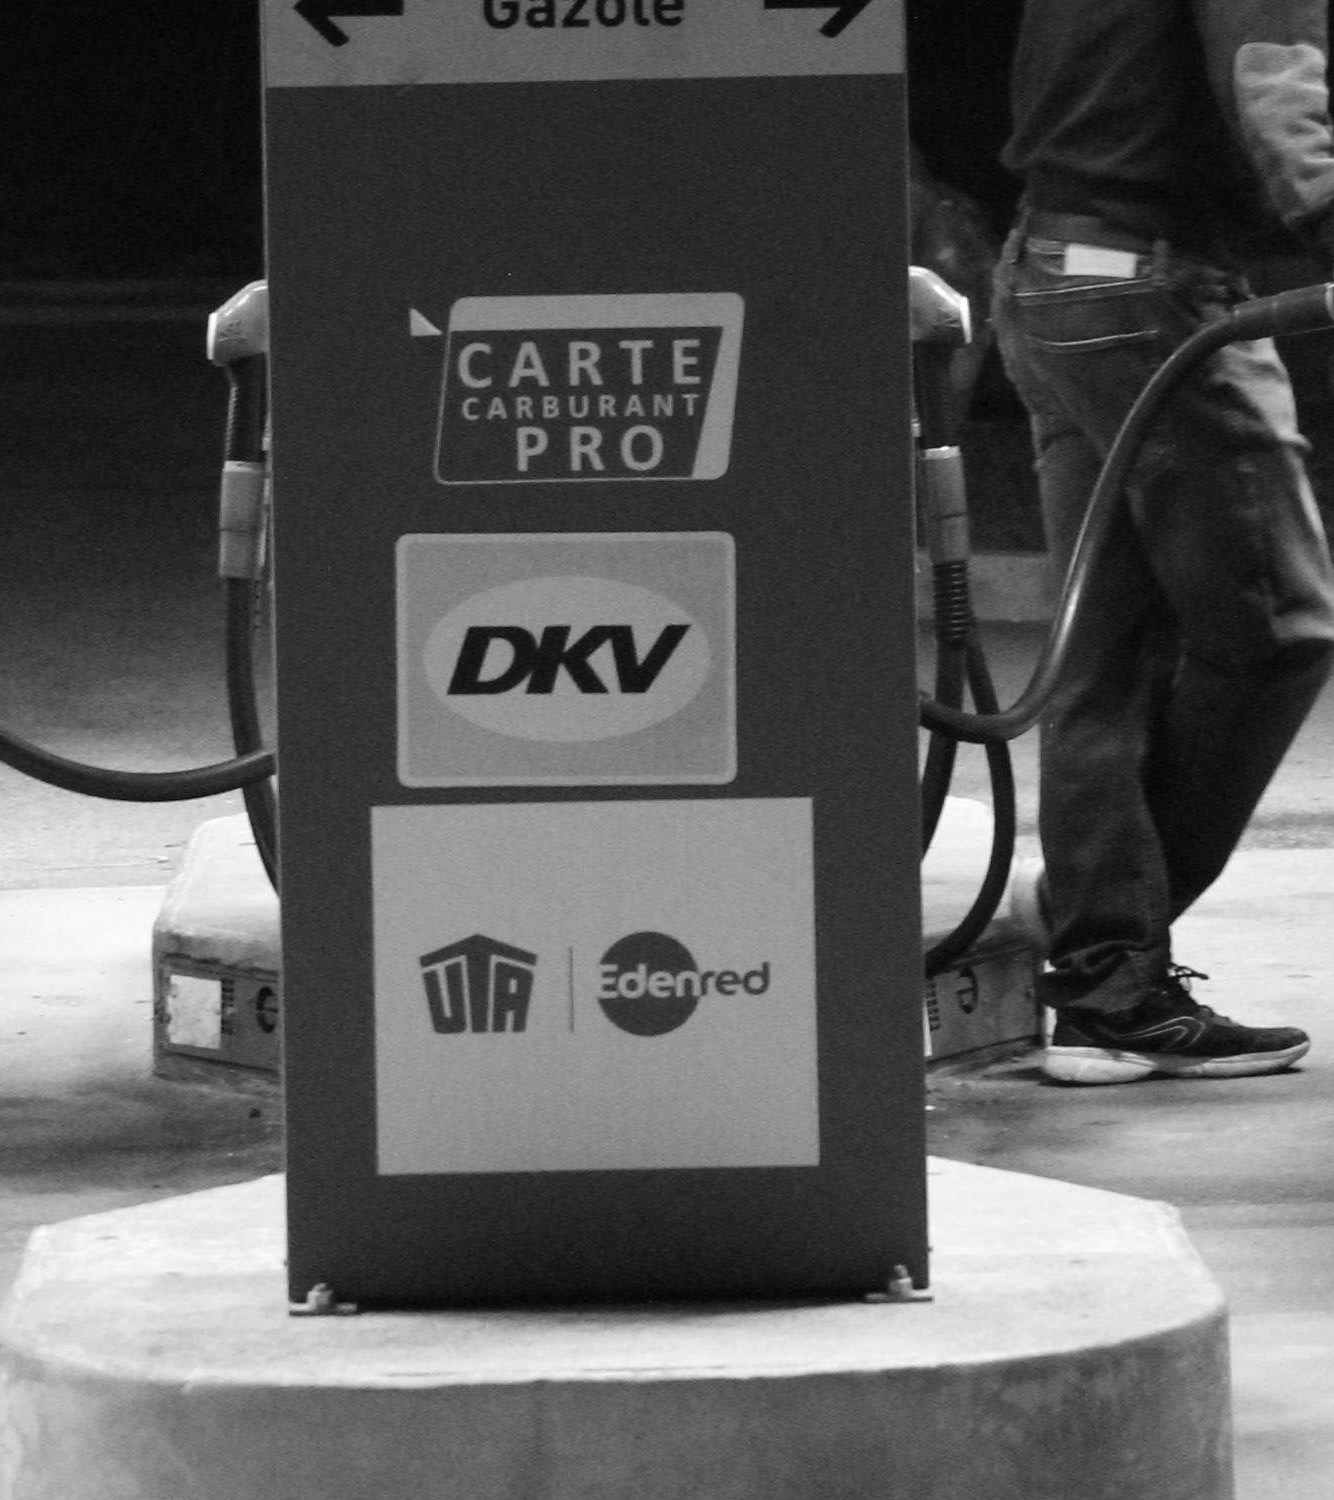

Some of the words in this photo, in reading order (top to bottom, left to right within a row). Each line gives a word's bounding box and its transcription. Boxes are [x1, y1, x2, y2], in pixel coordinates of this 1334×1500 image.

[457, 338, 702, 389] CARTE
[461, 393, 700, 421] CARBURANT
[516, 424, 665, 472] PRO
[447, 624, 691, 696] DKV
[419, 933, 538, 1035] UTA
[597, 962, 770, 1000] Edenred
